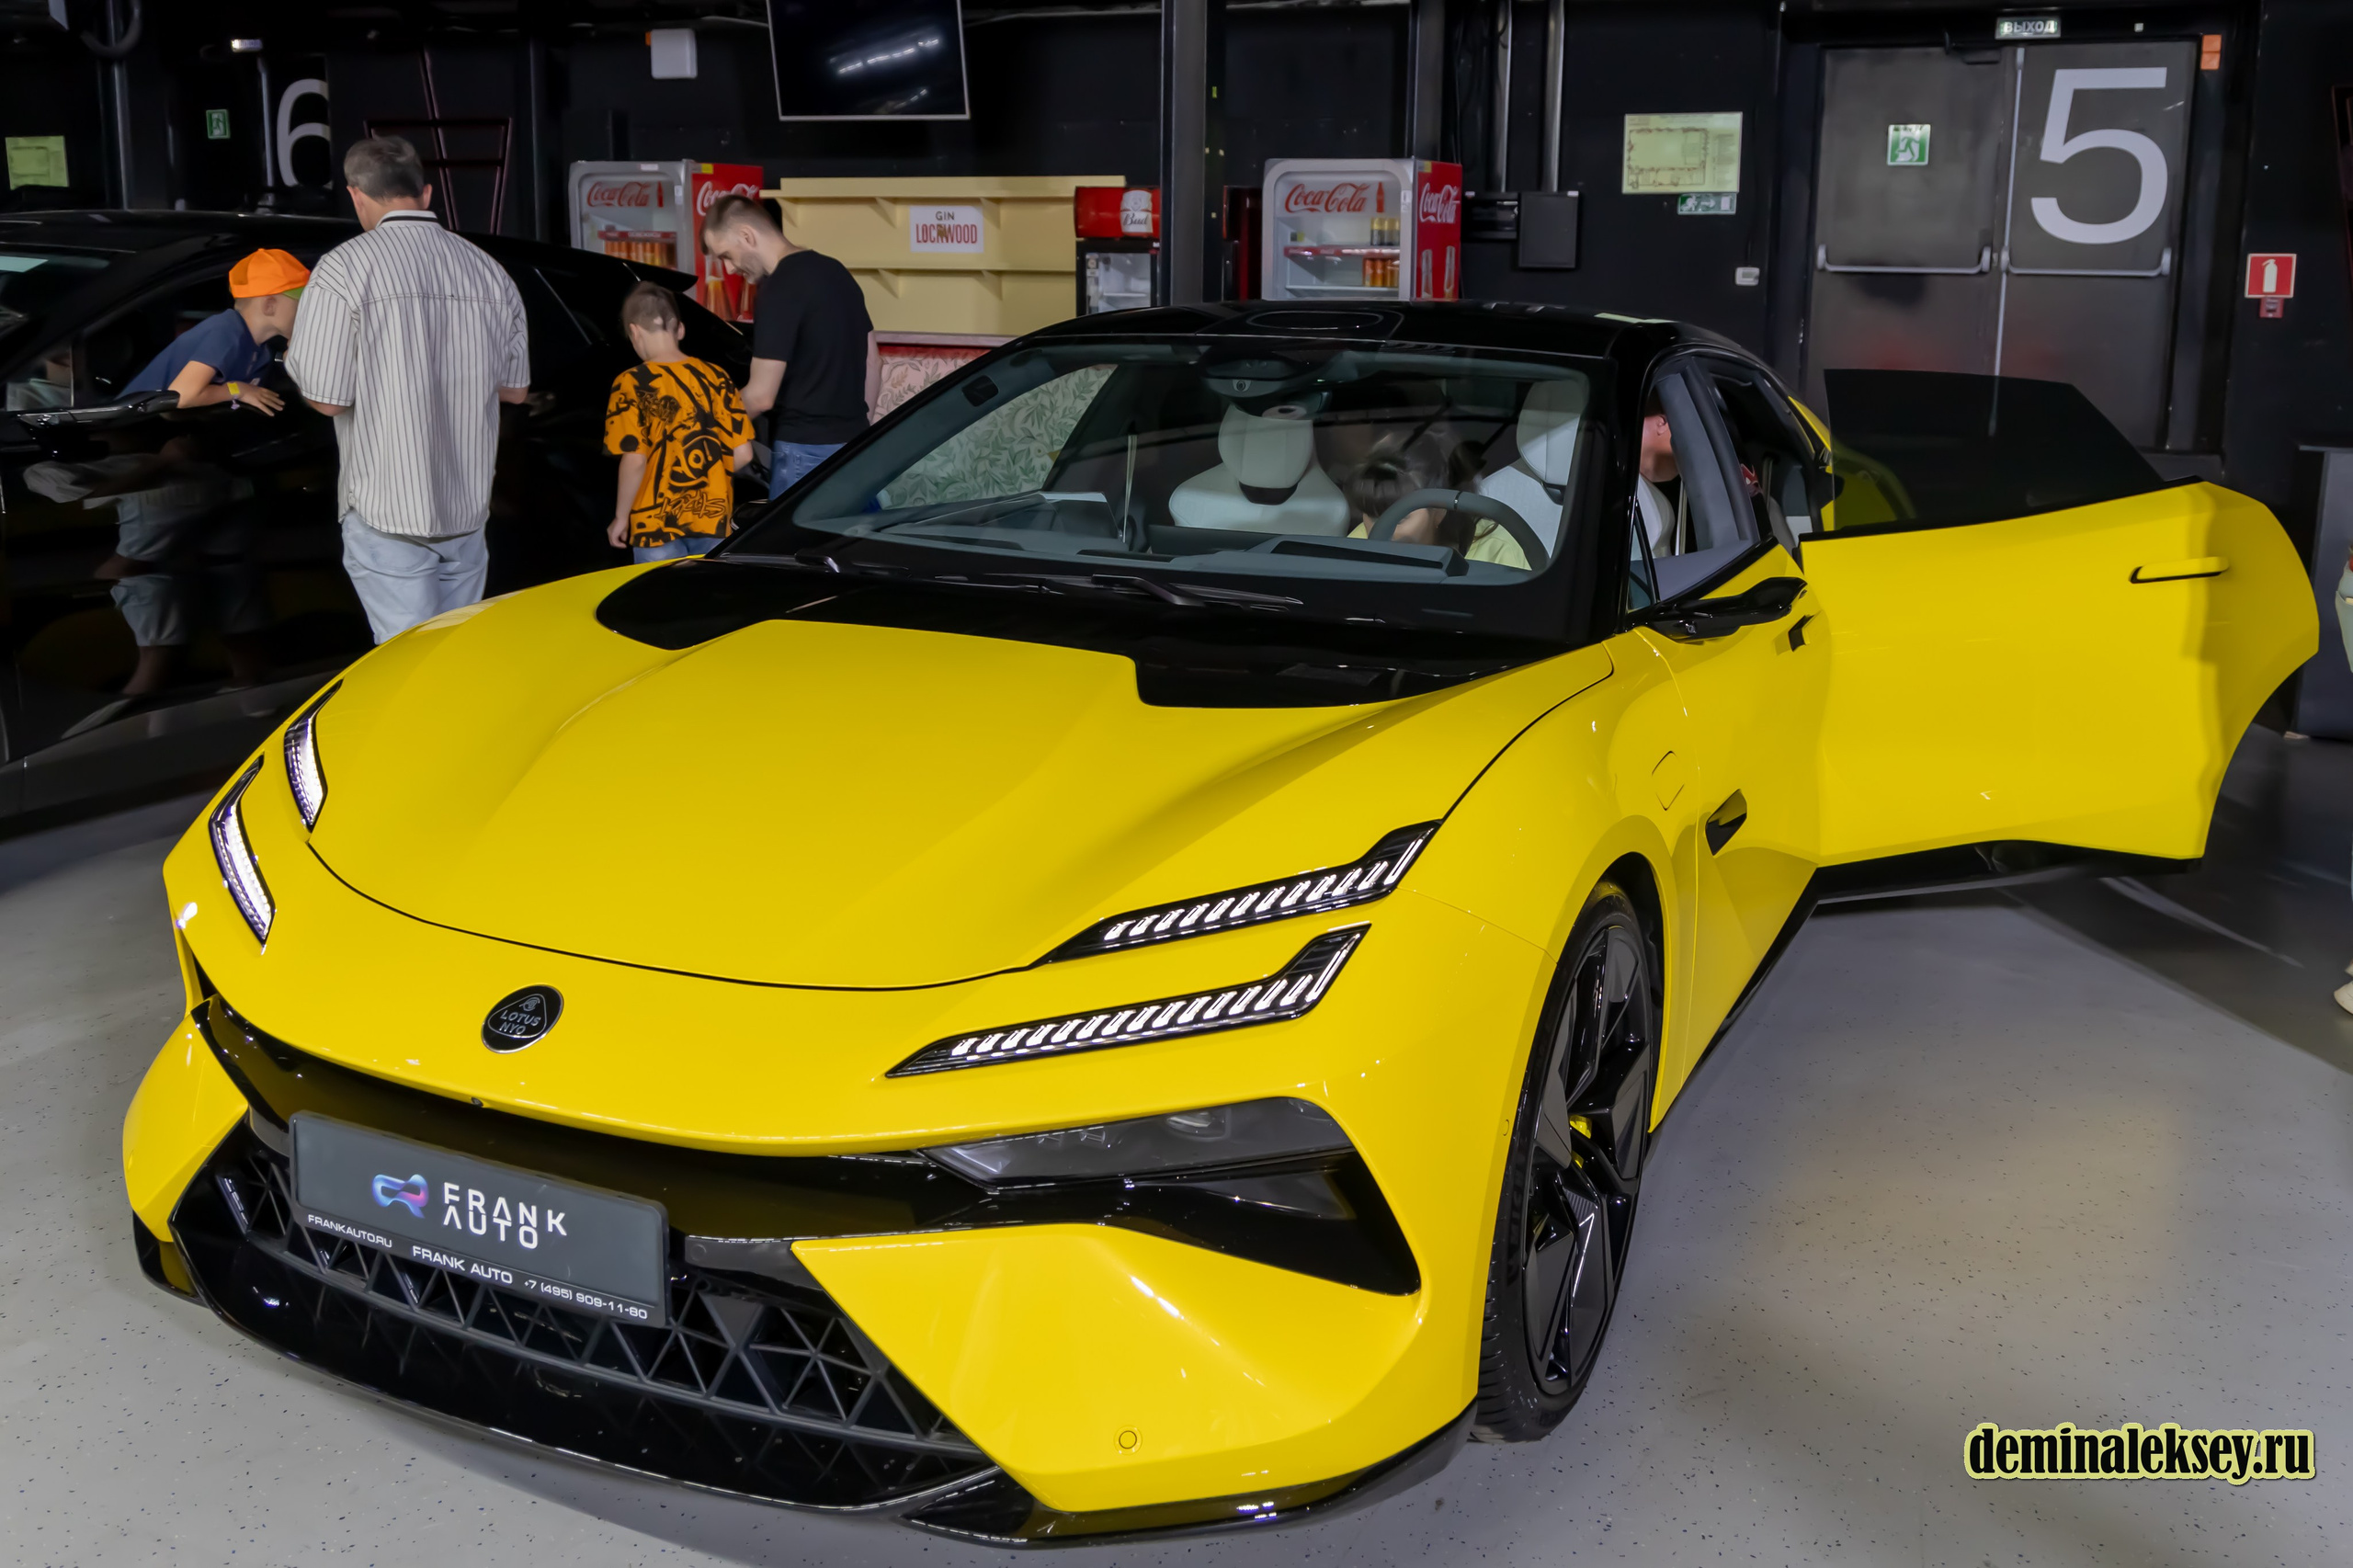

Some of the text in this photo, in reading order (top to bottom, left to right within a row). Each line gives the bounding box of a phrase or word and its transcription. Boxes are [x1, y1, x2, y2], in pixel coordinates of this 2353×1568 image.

[2002, 20, 2057, 34] ВЫХОД
[2030, 67, 2168, 244] 5
[935, 210, 955, 222] GIN
[1122, 212, 1149, 226] Bud
[500, 1009, 541, 1027] LOTUS
[499, 1021, 527, 1035] NYO
[444, 1182, 567, 1236] FRANK
[443, 1205, 539, 1249] AUTO
[308, 1214, 648, 1320] FRANKAUTO.RU FRANK AUTO +7 (495) 909-11-80
